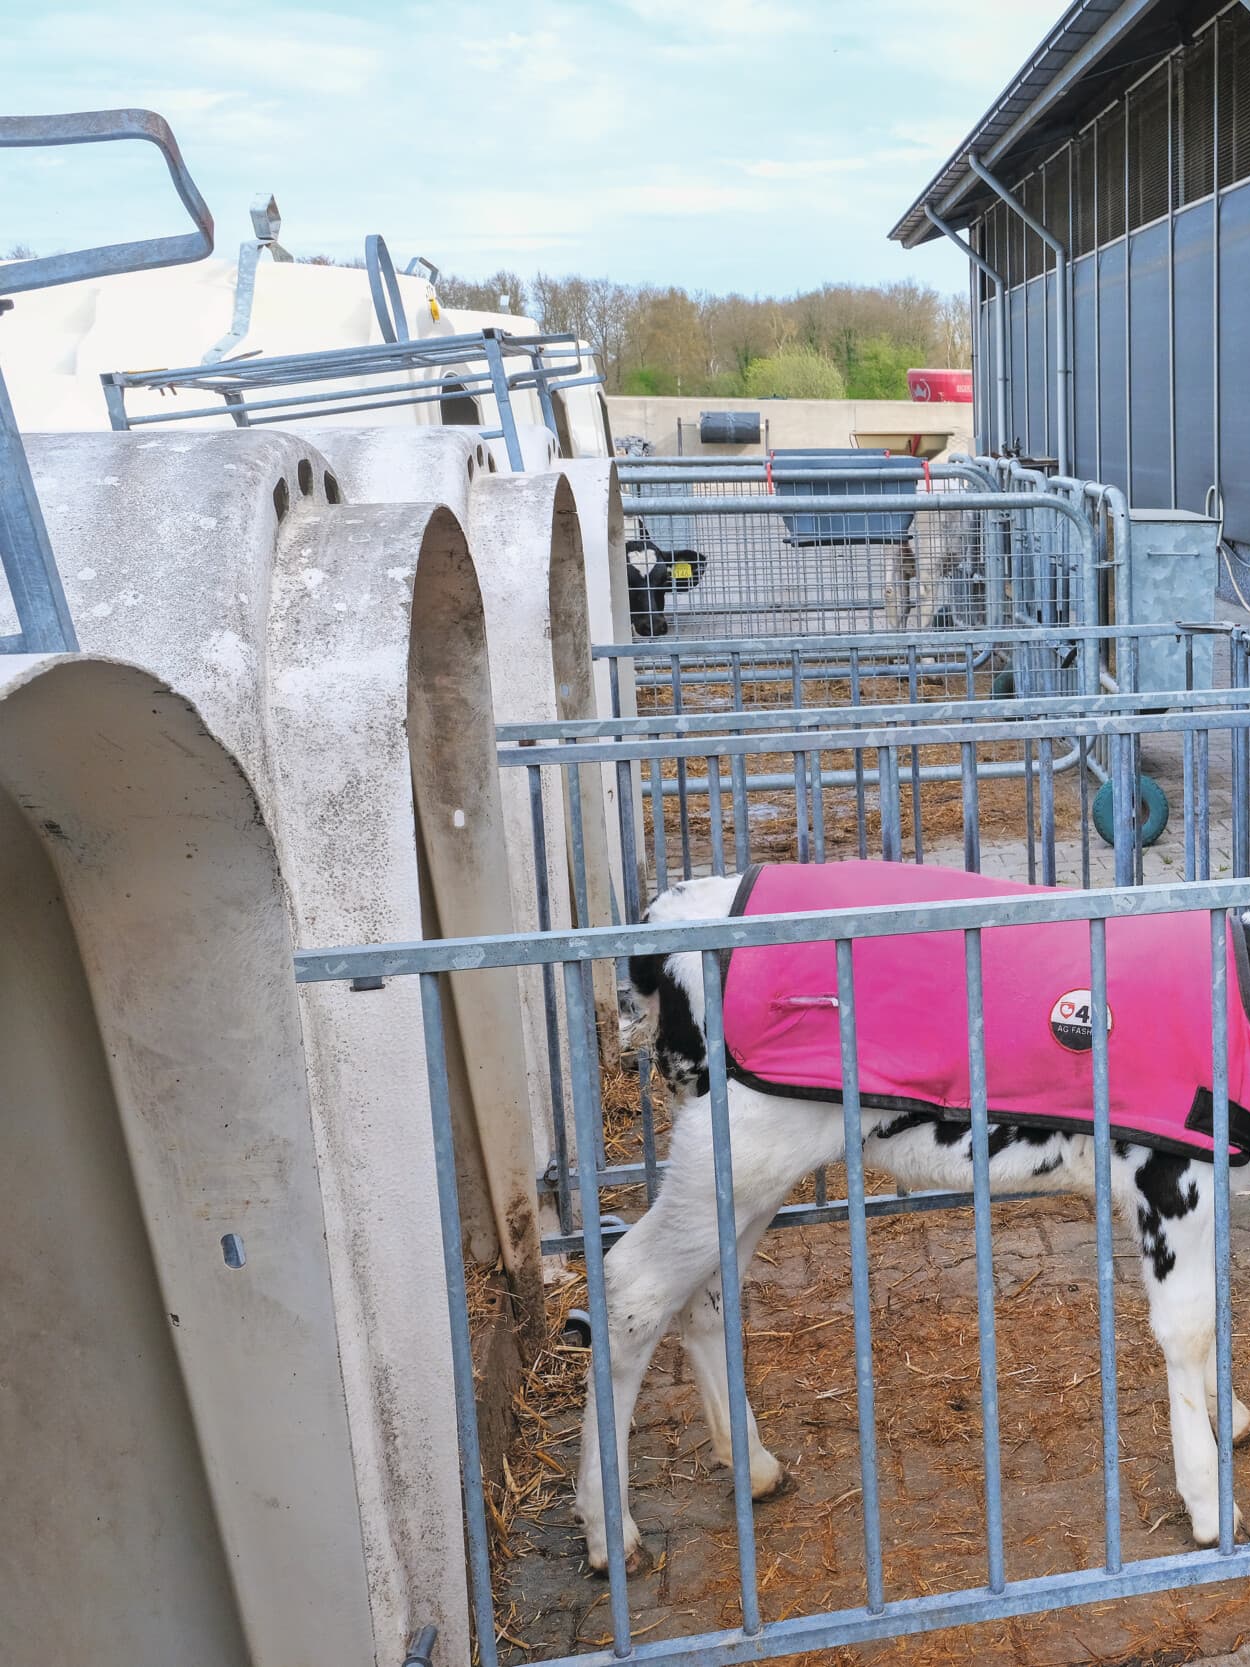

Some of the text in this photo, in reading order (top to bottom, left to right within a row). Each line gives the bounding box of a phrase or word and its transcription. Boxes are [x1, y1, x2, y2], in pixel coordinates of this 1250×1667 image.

[1075, 1005, 1090, 1024] 4
[1057, 1025, 1092, 1036] AG FASH
